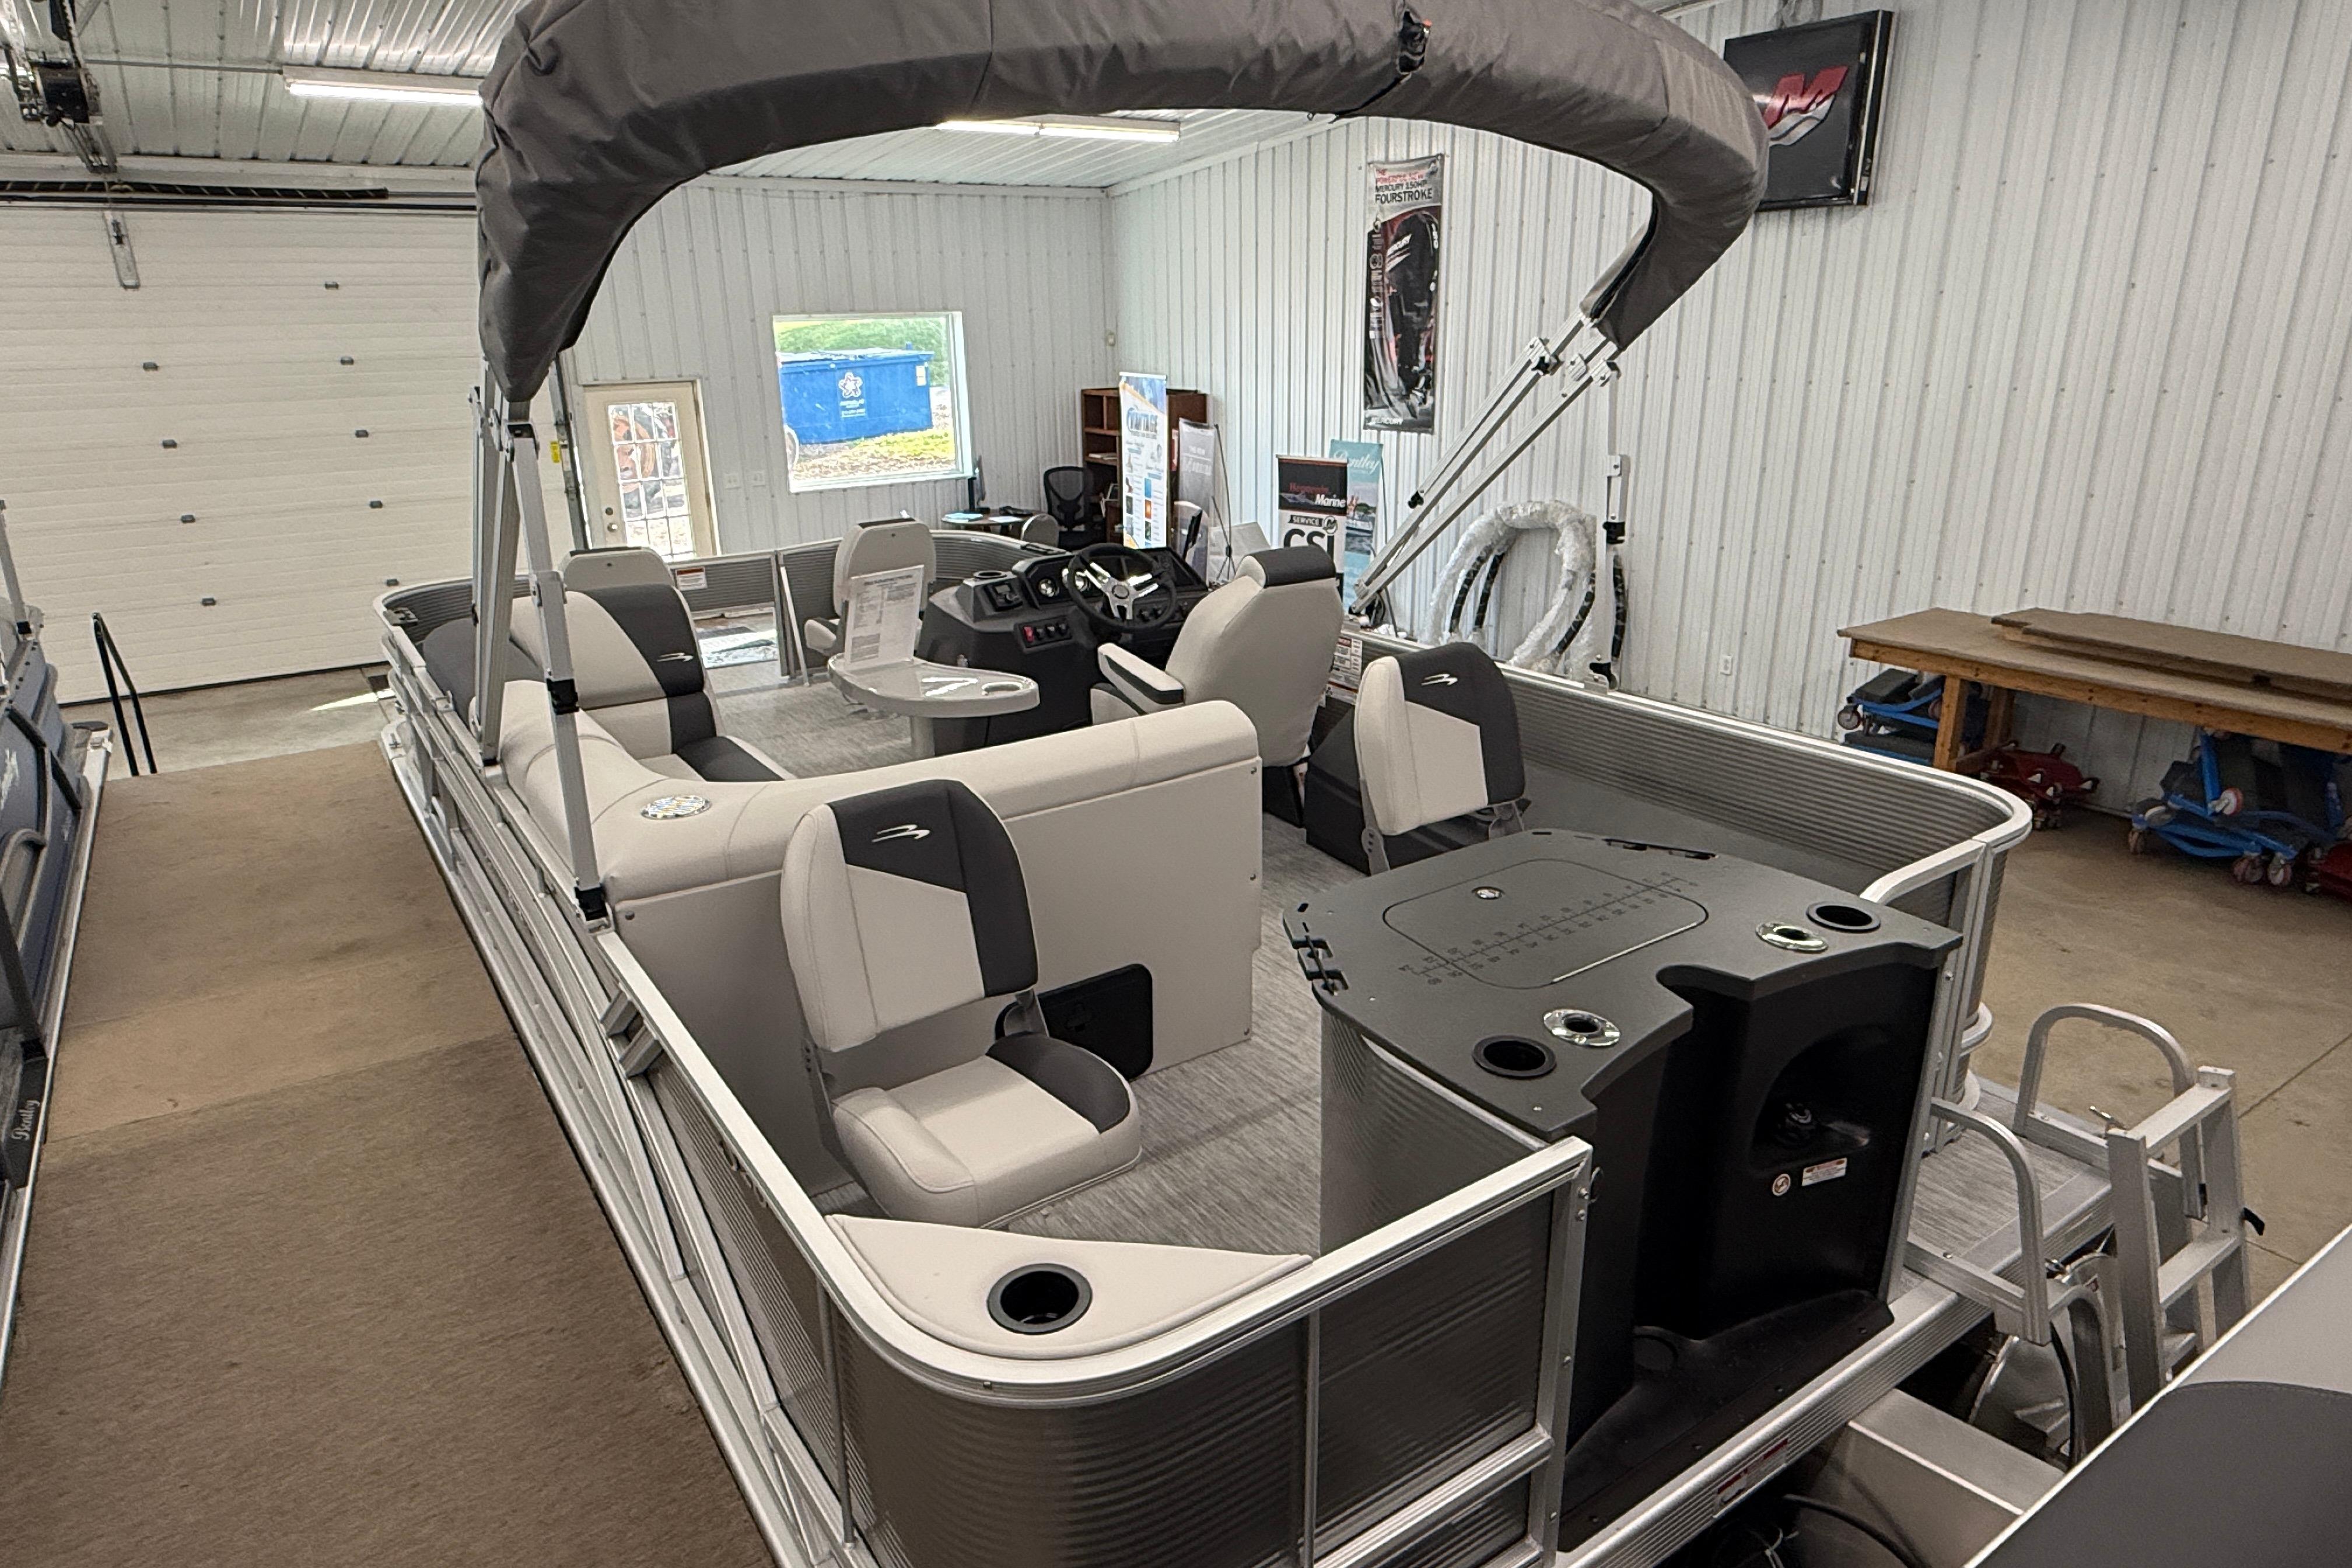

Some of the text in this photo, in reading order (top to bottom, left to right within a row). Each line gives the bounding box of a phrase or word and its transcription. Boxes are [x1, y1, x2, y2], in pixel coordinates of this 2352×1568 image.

[1375, 188, 1433, 204] FOURSTROKE
[1315, 494, 1346, 508] Marine
[1293, 516, 1320, 526] SERVICE
[12, 1099, 41, 1141] Bentley
